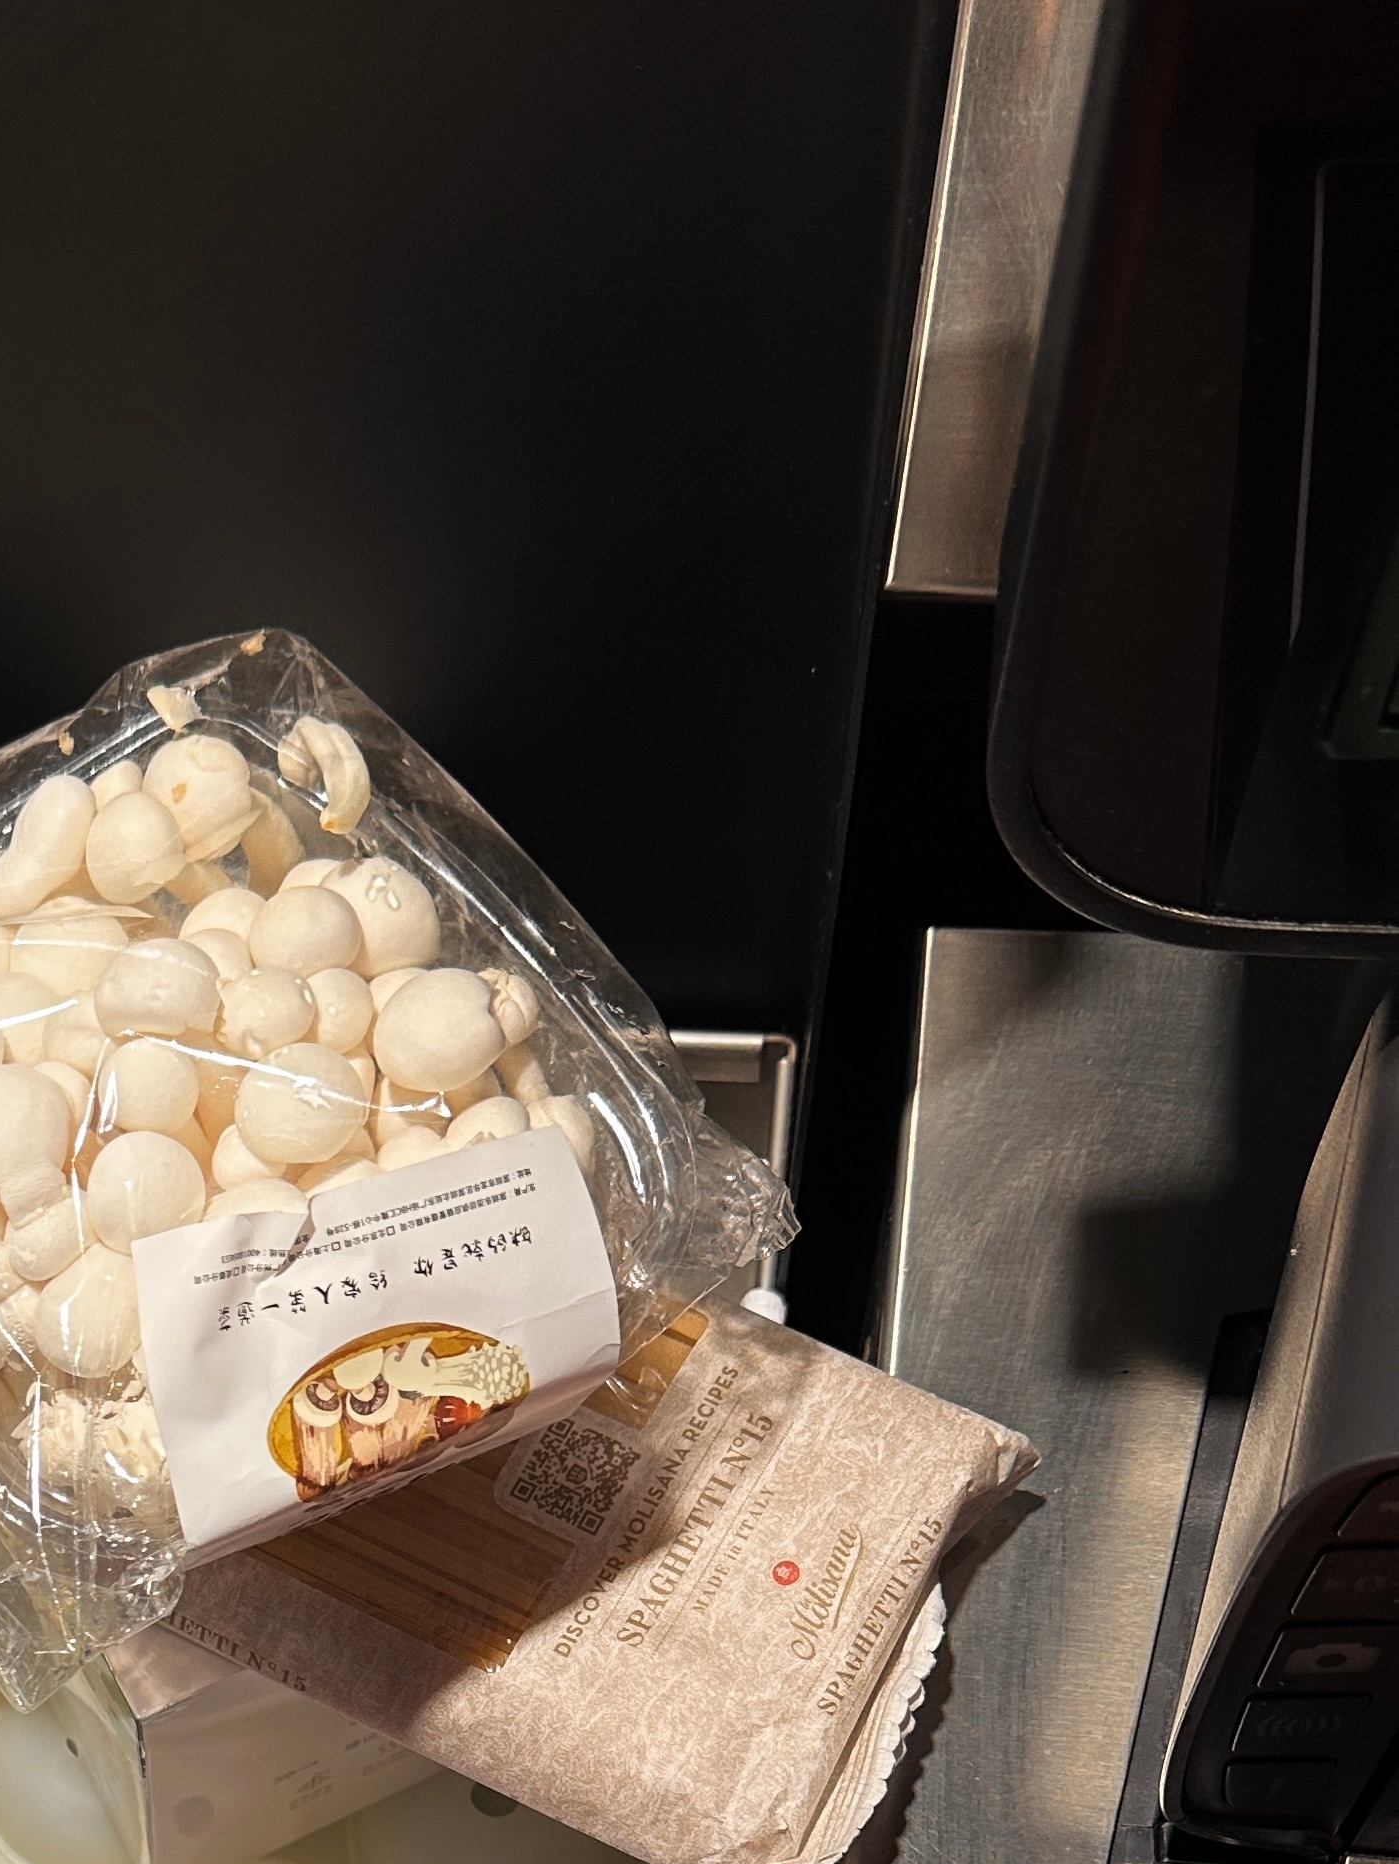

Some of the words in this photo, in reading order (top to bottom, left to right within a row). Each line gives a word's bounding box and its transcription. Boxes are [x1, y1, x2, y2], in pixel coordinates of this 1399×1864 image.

[412, 1225, 533, 1278] 缺的就是你
[552, 1549, 628, 1658] DISCOVER
[615, 1442, 690, 1554] MOLISANA
[681, 1363, 740, 1444] RECIPES
[615, 1471, 736, 1649] SPAGHETTI
[720, 1407, 775, 1473] N°15
[691, 1561, 730, 1614] MADE
[734, 1484, 776, 1540] ITALY
[787, 1522, 862, 1657] Molisana
[814, 1574, 909, 1716] SPAGHETTI
[897, 1514, 943, 1573] N°15
